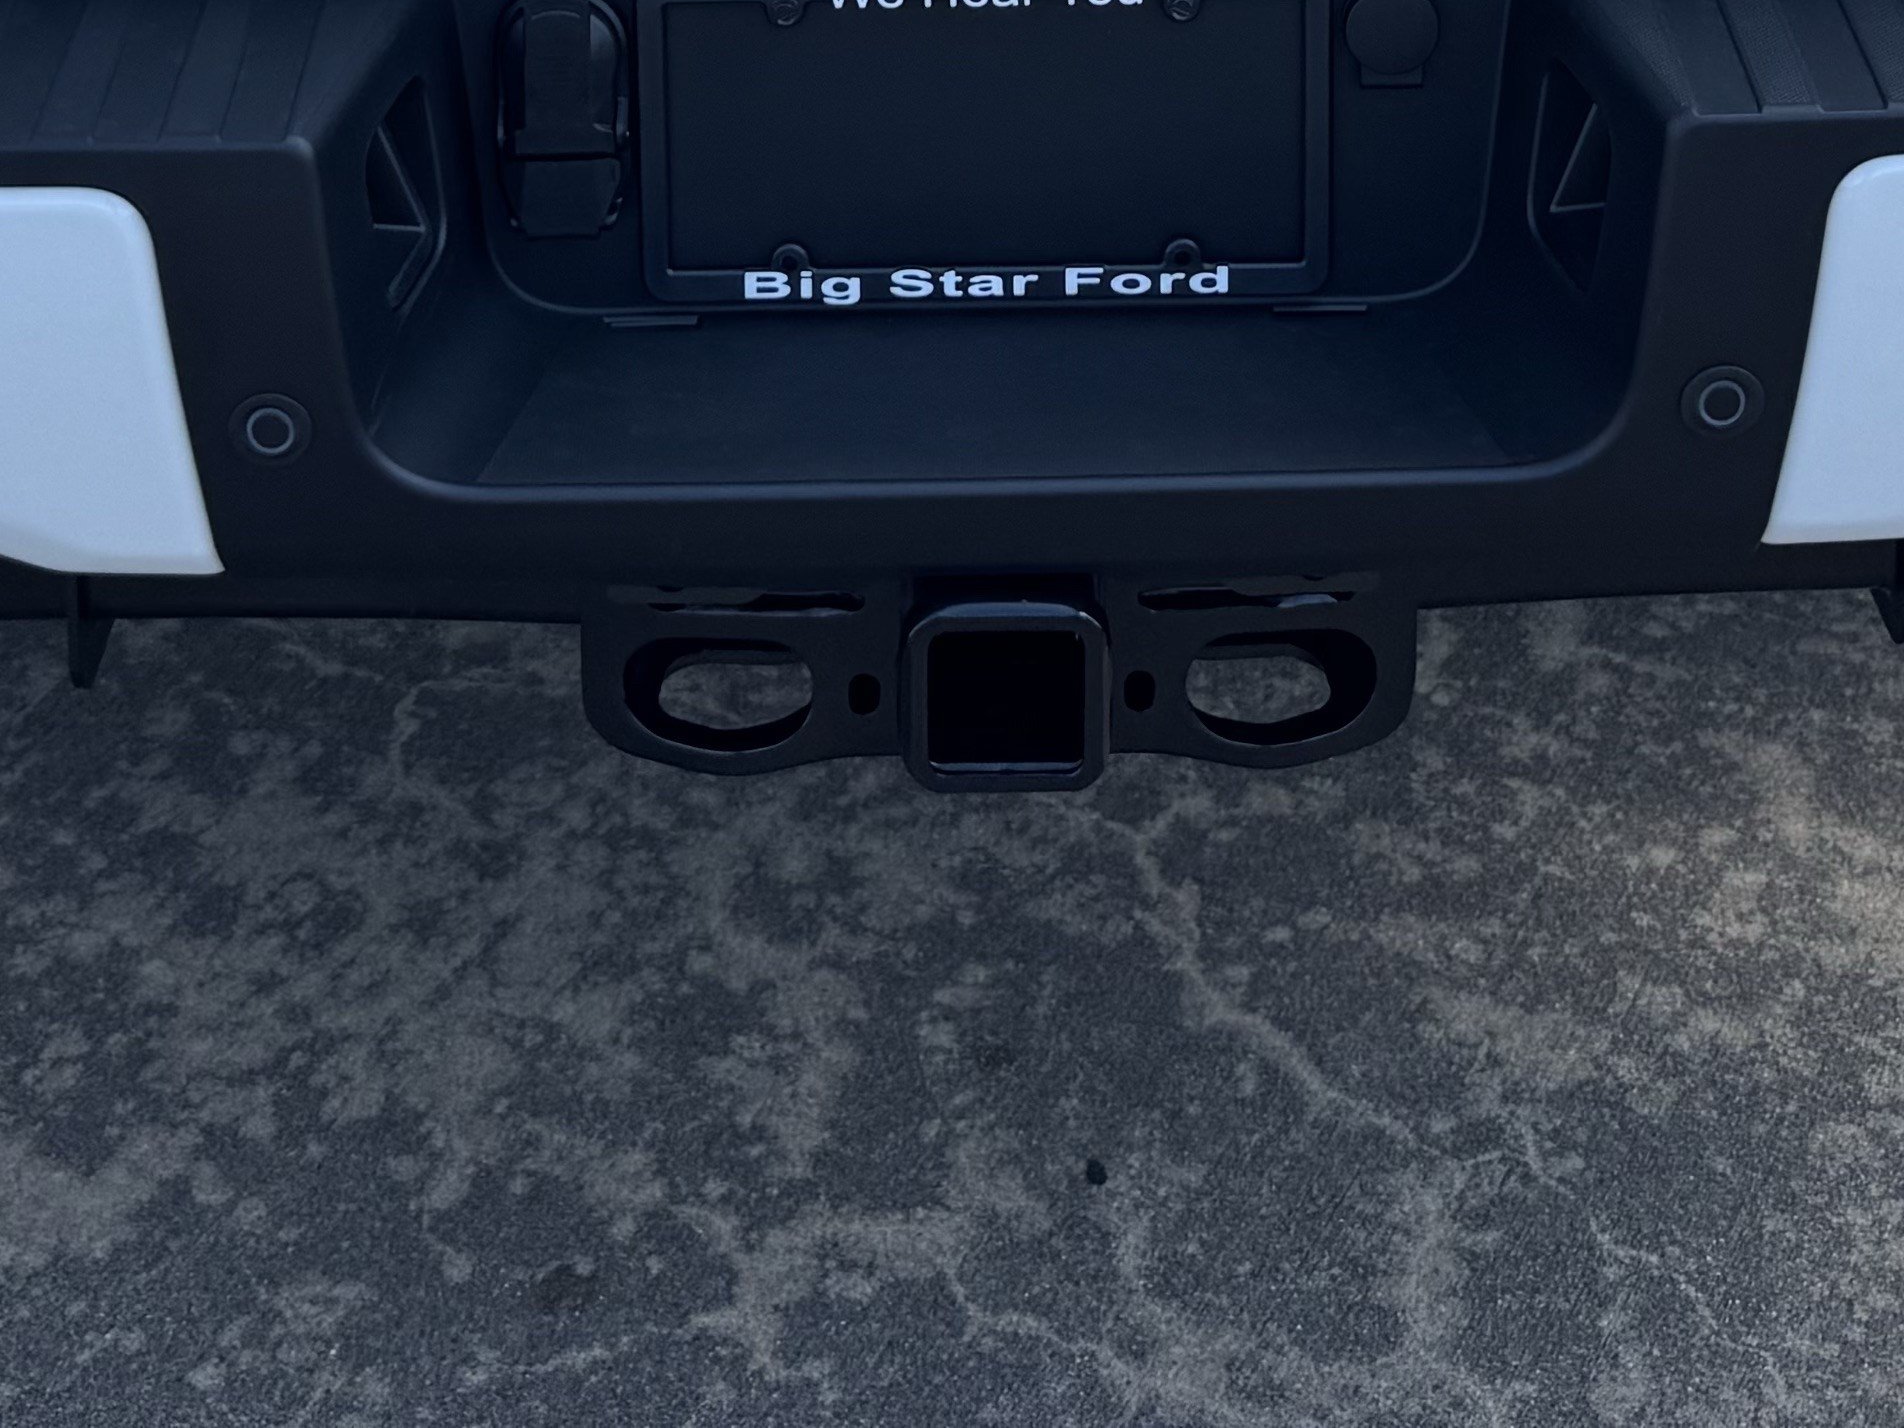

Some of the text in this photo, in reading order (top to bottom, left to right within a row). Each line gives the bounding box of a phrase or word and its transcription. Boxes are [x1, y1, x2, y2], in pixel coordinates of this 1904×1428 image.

[744, 265, 1229, 306] Big Star Ford
